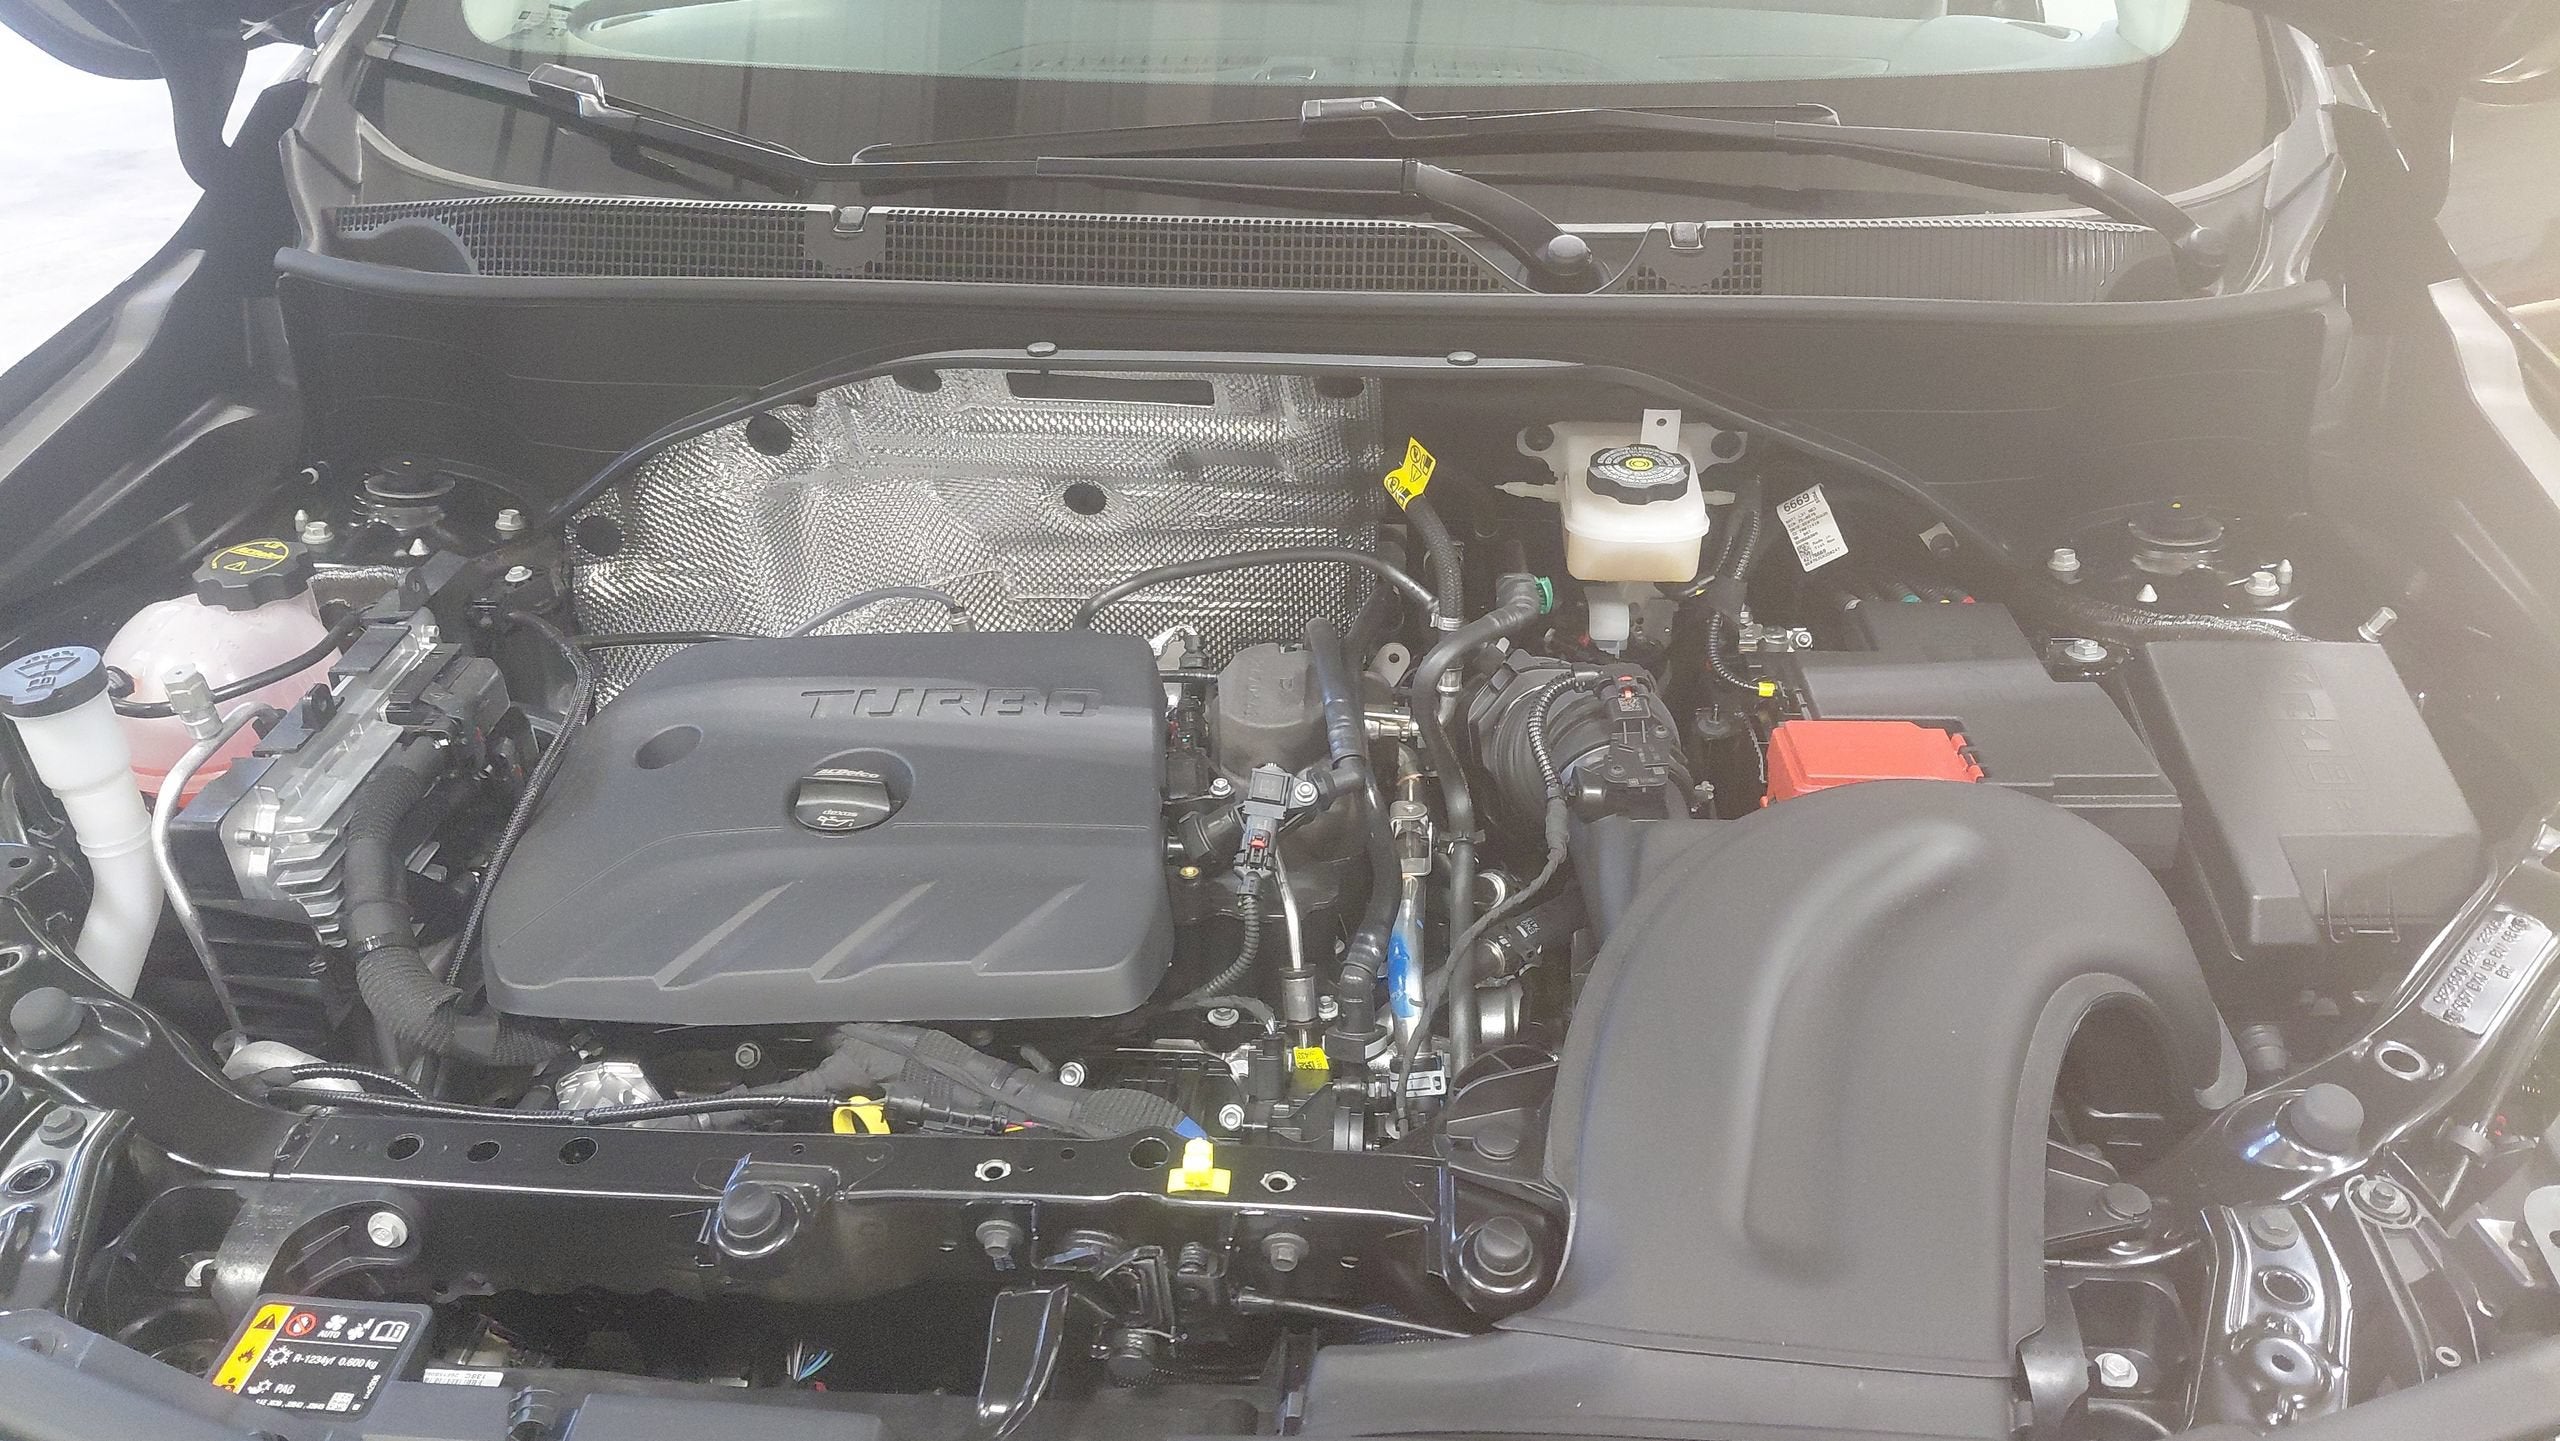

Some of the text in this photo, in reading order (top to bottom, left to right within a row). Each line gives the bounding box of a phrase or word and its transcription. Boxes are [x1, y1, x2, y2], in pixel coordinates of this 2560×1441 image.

[1784, 493, 1810, 512] 6669
[800, 688, 1104, 719] TURBO
[813, 768, 880, 779] ACDelco
[317, 1330, 341, 1339] AUTO
[292, 1353, 379, 1370] R-1234yf 0.600 kg
[273, 1383, 296, 1395] PAG
